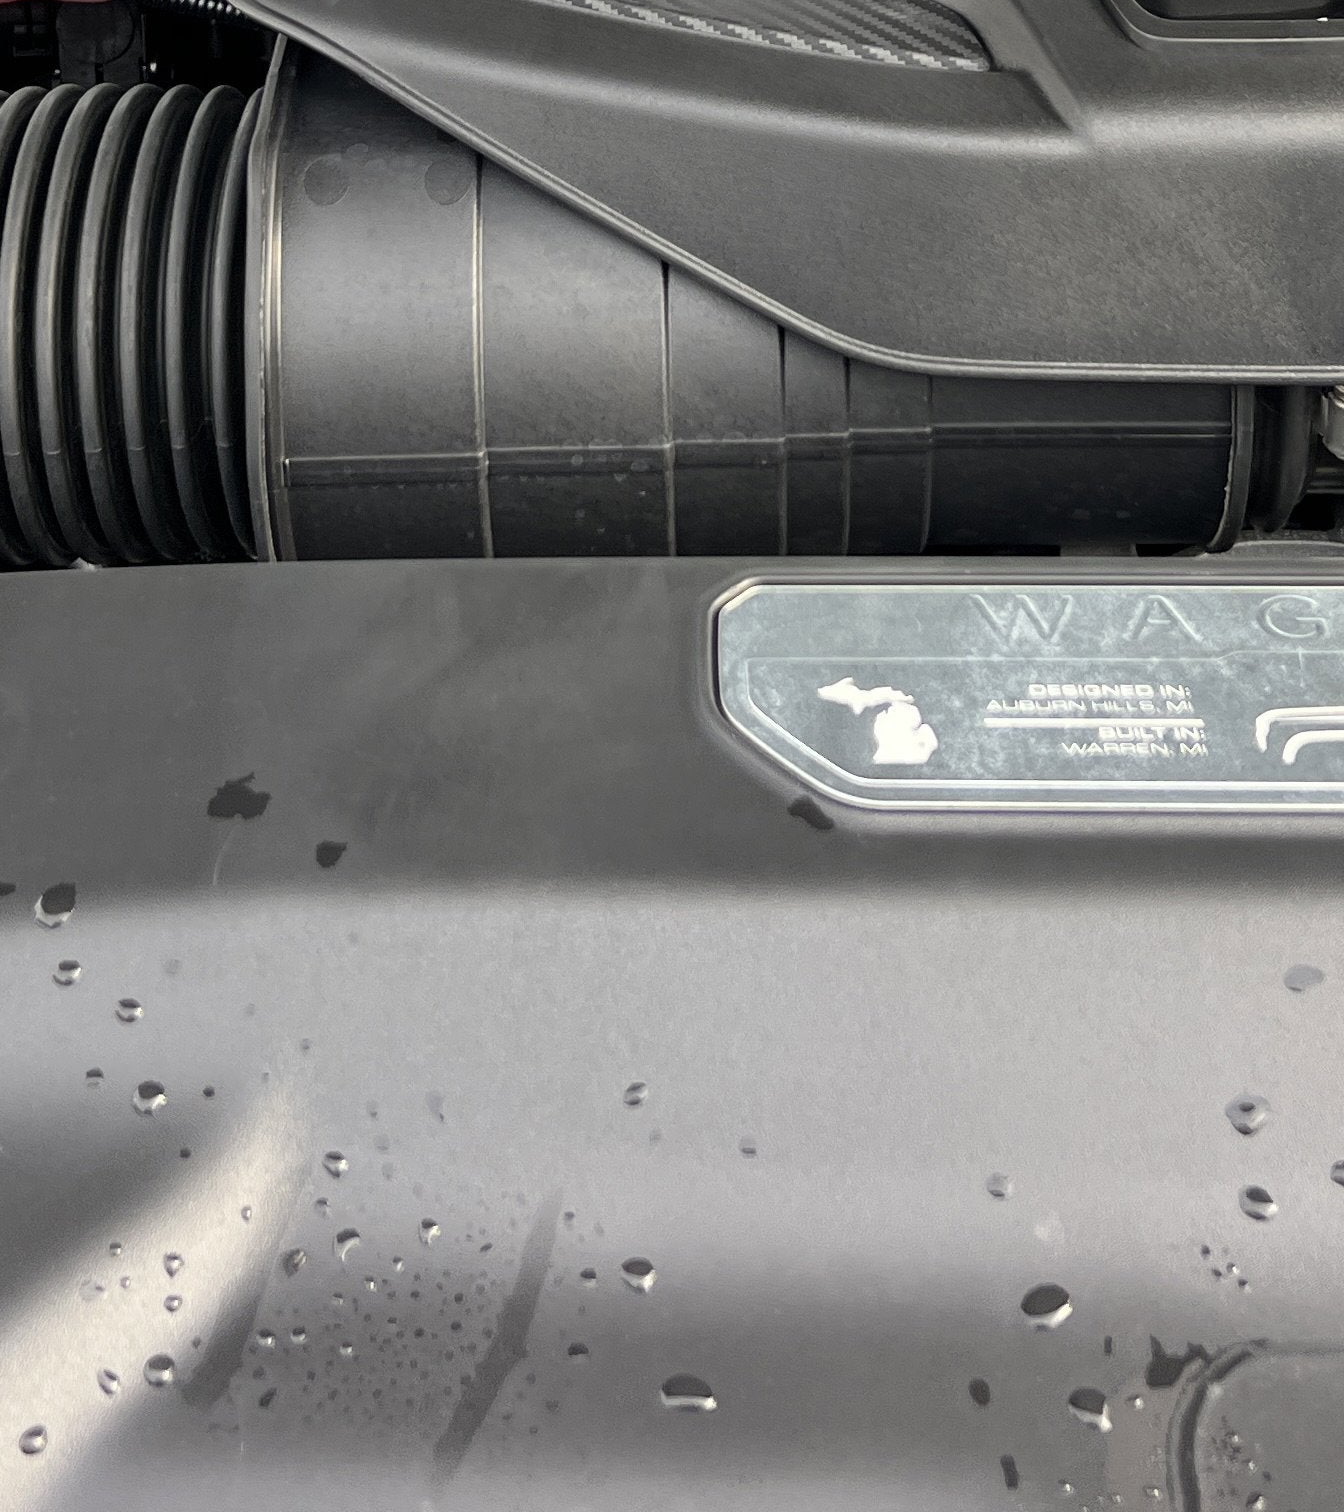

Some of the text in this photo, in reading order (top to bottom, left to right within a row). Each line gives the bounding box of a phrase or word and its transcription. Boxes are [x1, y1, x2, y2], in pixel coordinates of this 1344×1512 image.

[1027, 683, 1192, 698] DESIGNED IN:
[985, 699, 1087, 713] AUBURN
[1166, 699, 1194, 713] MI
[1098, 725, 1206, 740] BUILT IN:
[1179, 742, 1208, 756] MI
